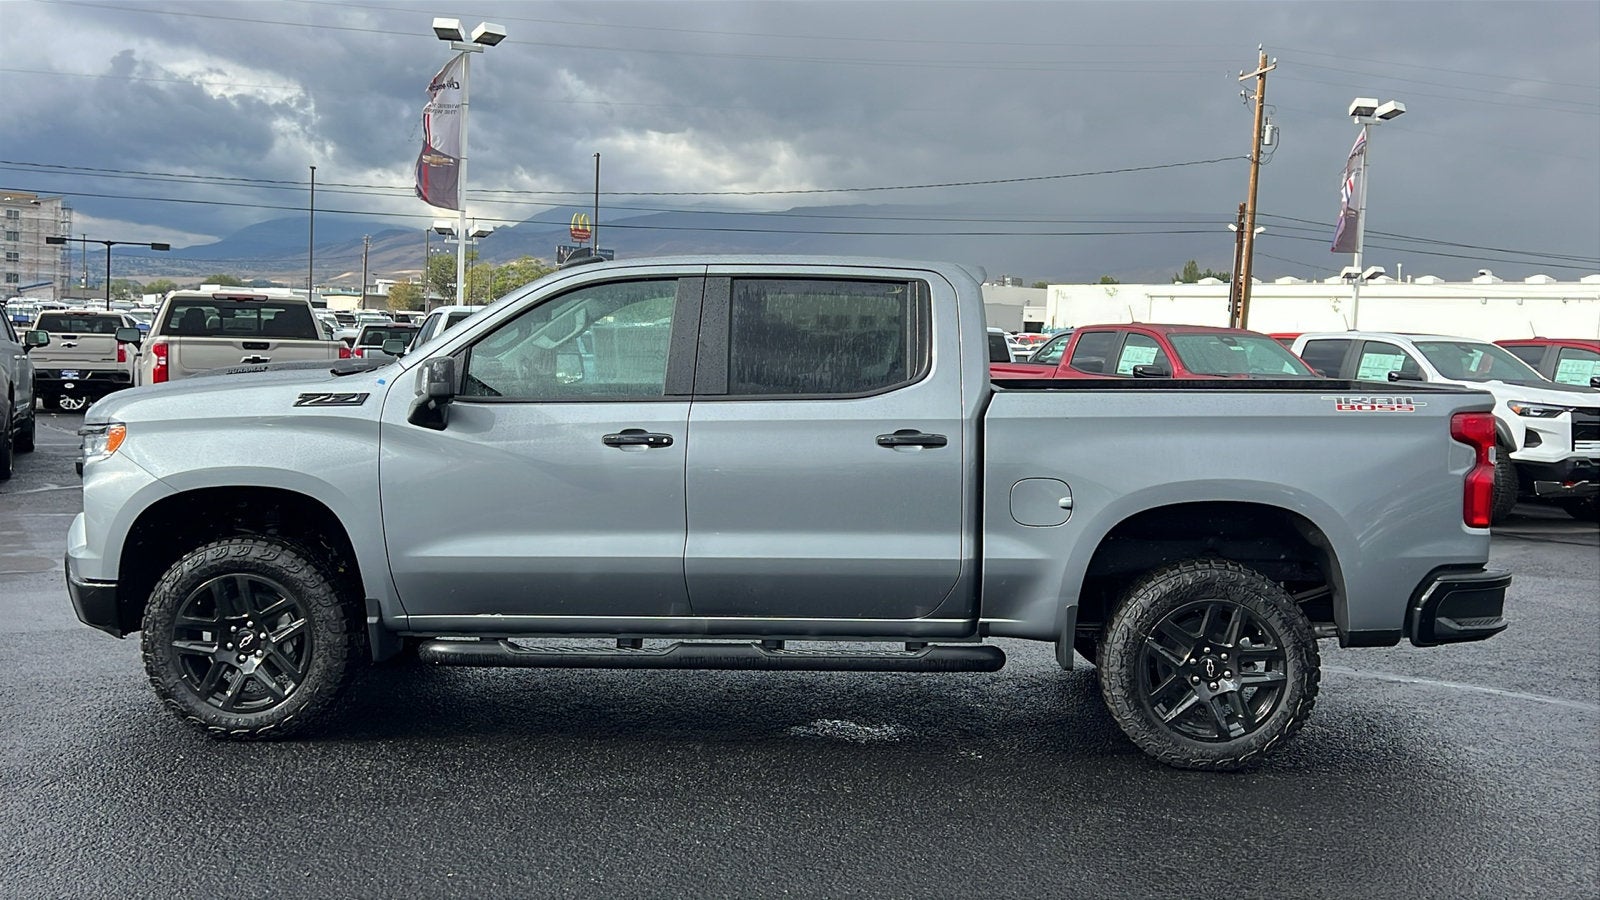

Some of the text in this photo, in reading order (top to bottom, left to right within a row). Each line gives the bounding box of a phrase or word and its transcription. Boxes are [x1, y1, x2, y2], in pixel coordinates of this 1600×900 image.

[292, 393, 370, 407] Z71
[1322, 396, 1427, 405] TRAIL
[1336, 404, 1415, 412] BOSS
